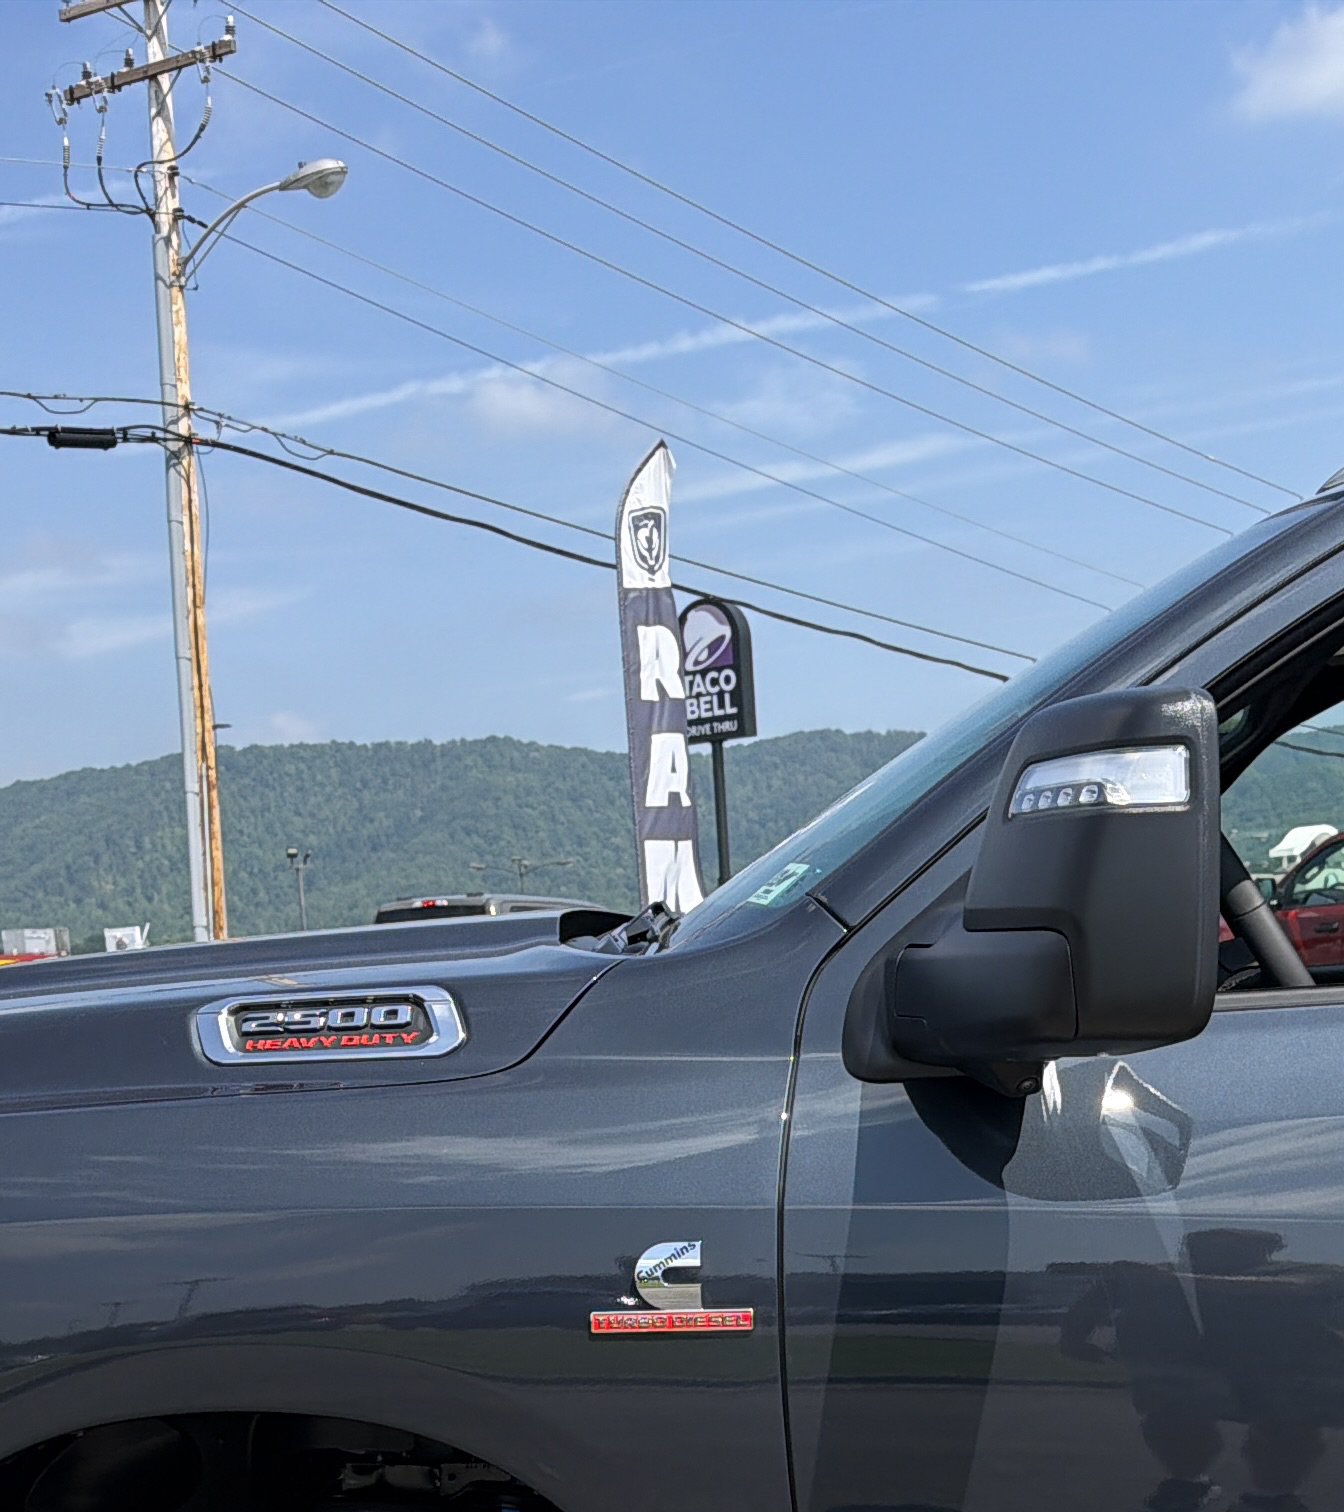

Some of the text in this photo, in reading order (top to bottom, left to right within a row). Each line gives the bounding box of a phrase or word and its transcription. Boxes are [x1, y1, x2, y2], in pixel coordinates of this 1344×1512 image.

[684, 668, 736, 696] TACO
[686, 692, 738, 720] BELL
[713, 719, 738, 733] THRU
[241, 1005, 413, 1034] 2500
[246, 1032, 420, 1051] HEAVY DUTY
[672, 1314, 749, 1327] DIESEL
